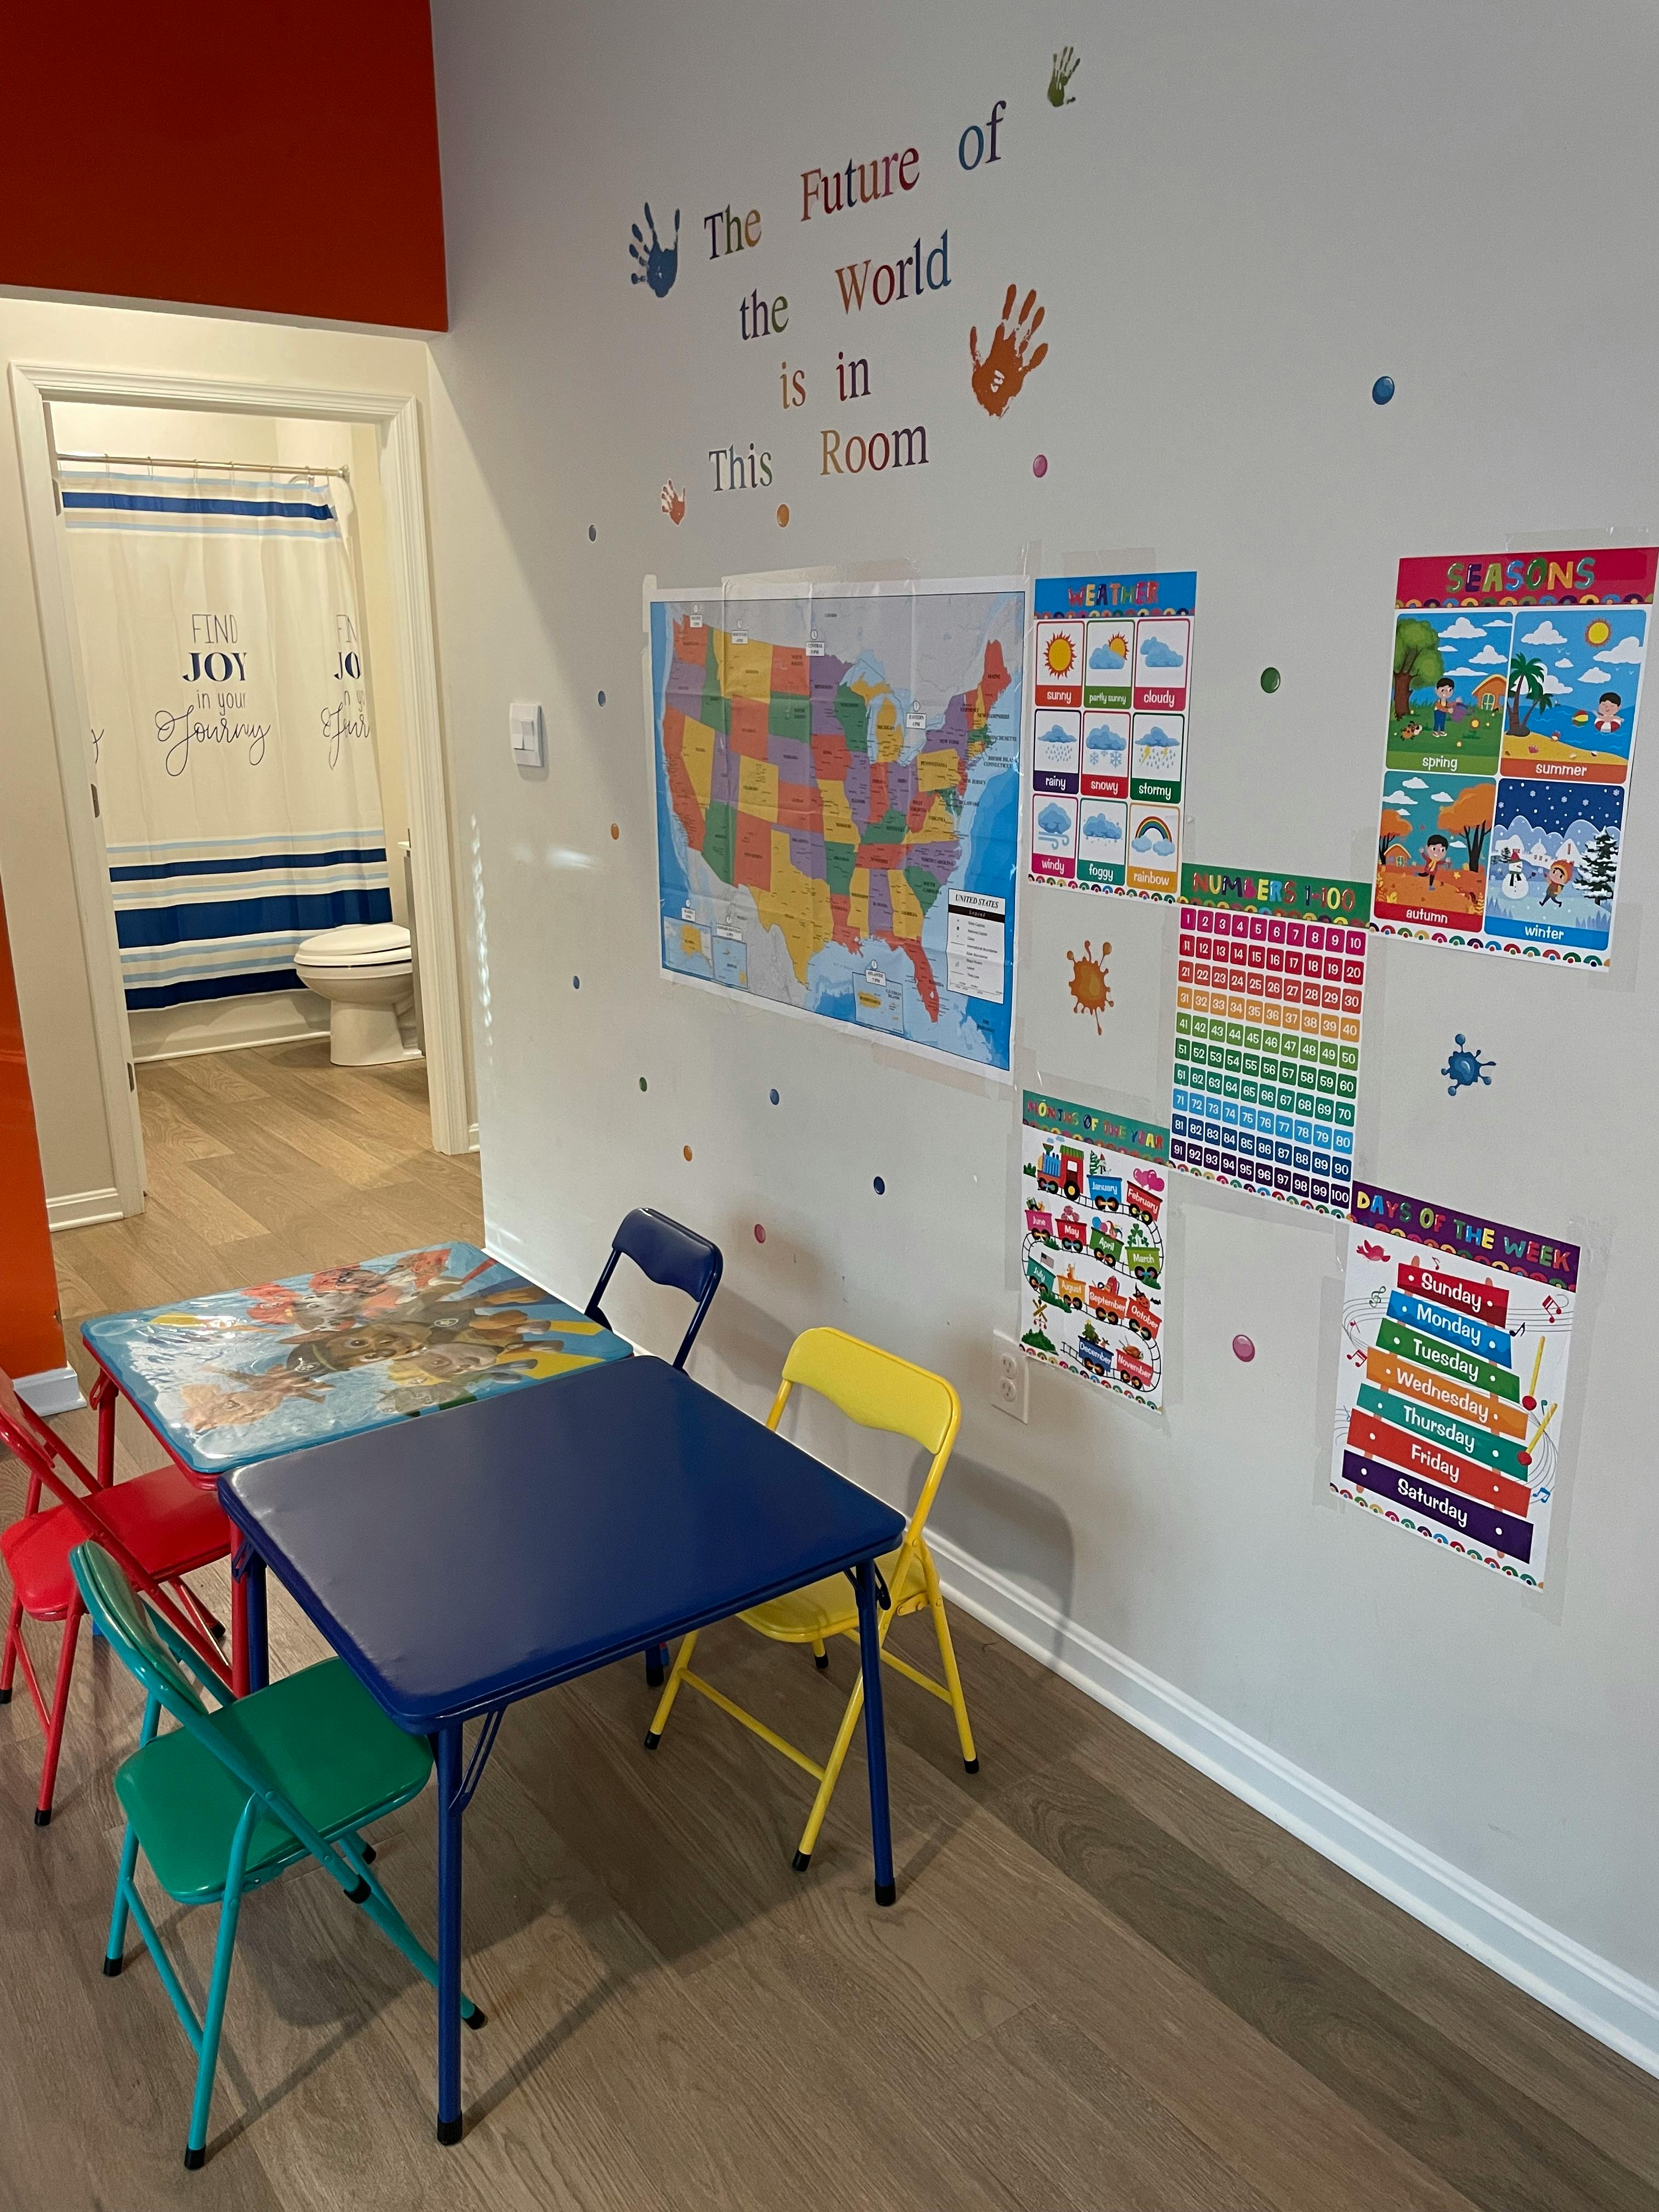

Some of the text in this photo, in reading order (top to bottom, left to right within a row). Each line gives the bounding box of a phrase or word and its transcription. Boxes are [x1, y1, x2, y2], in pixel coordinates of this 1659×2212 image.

[704, 100, 1007, 259] The Future of
[739, 229, 952, 340] the World
[780, 352, 871, 409] is in
[708, 425, 929, 492] This Room
[1447, 557, 1595, 593] SEASONS
[1068, 579, 1159, 607] WEATHER
[192, 614, 238, 644] FIND
[182, 652, 247, 681] JOY
[334, 651, 360, 680] JO
[196, 689, 246, 716] in your
[1047, 691, 1071, 704] sunny
[1089, 692, 1126, 704] partly sunny
[1144, 690, 1175, 707] cloudy
[155, 704, 271, 776] Journy
[1422, 755, 1458, 771] spring
[1536, 763, 1587, 776] summer
[1046, 775, 1066, 791] rainy
[1091, 780, 1118, 795] snowy
[1139, 784, 1171, 800] stormy
[1042, 859, 1064, 874] windy
[1089, 864, 1113, 881] foggy
[1133, 872, 1170, 886] rainbow
[955, 894, 999, 909] UNITED STATES
[1193, 872, 1356, 911] NUMBERS 1-100
[1406, 908, 1448, 924] autumn
[1187, 914, 1361, 949] 1 2 3 4 5 6 7 8 9 10
[1525, 924, 1564, 940] winter
[1184, 940, 1361, 978] 11 12 13 14 15 16 17 18 19 20
[1181, 966, 1359, 1007] 21 22 23 24 25 26 27 28 29 30
[1179, 1019, 1356, 1064] 41 42 43 44 45 46 47 48 49 50
[1178, 1043, 1354, 1092] 51 52 53 54 55 56 57 58 59 60
[1177, 1069, 1351, 1120] 61 62 63 64 65 66 67 68 69 70
[1027, 1100, 1163, 1149] MONTHS OF THE YEAR
[1175, 1119, 1349, 1175] 81 82 83 84 85 86 87 88 89 90
[1174, 1144, 1349, 1203] 91 92 93 94 95 96 97 98 99 100
[1092, 1182, 1118, 1195] January
[1127, 1189, 1158, 1213] February
[1032, 1216, 1046, 1226] June
[1064, 1224, 1080, 1238] May
[1357, 1191, 1571, 1272] DAYS OF THE WEEK
[1098, 1237, 1114, 1251] April
[1133, 1254, 1154, 1263] March
[1034, 1267, 1046, 1283] July
[1062, 1281, 1082, 1294] August
[1090, 1291, 1126, 1312] September
[1421, 1273, 1482, 1313] Sunday
[1131, 1305, 1158, 1329] October
[1417, 1304, 1481, 1346] Monday
[1080, 1341, 1111, 1365] December
[1118, 1355, 1152, 1379] November
[1413, 1338, 1479, 1383] Tuesday
[1396, 1368, 1489, 1423] Wednesday
[1403, 1404, 1475, 1453] Thursday
[1411, 1443, 1460, 1483] Friday
[1397, 1477, 1468, 1528] Saturday
